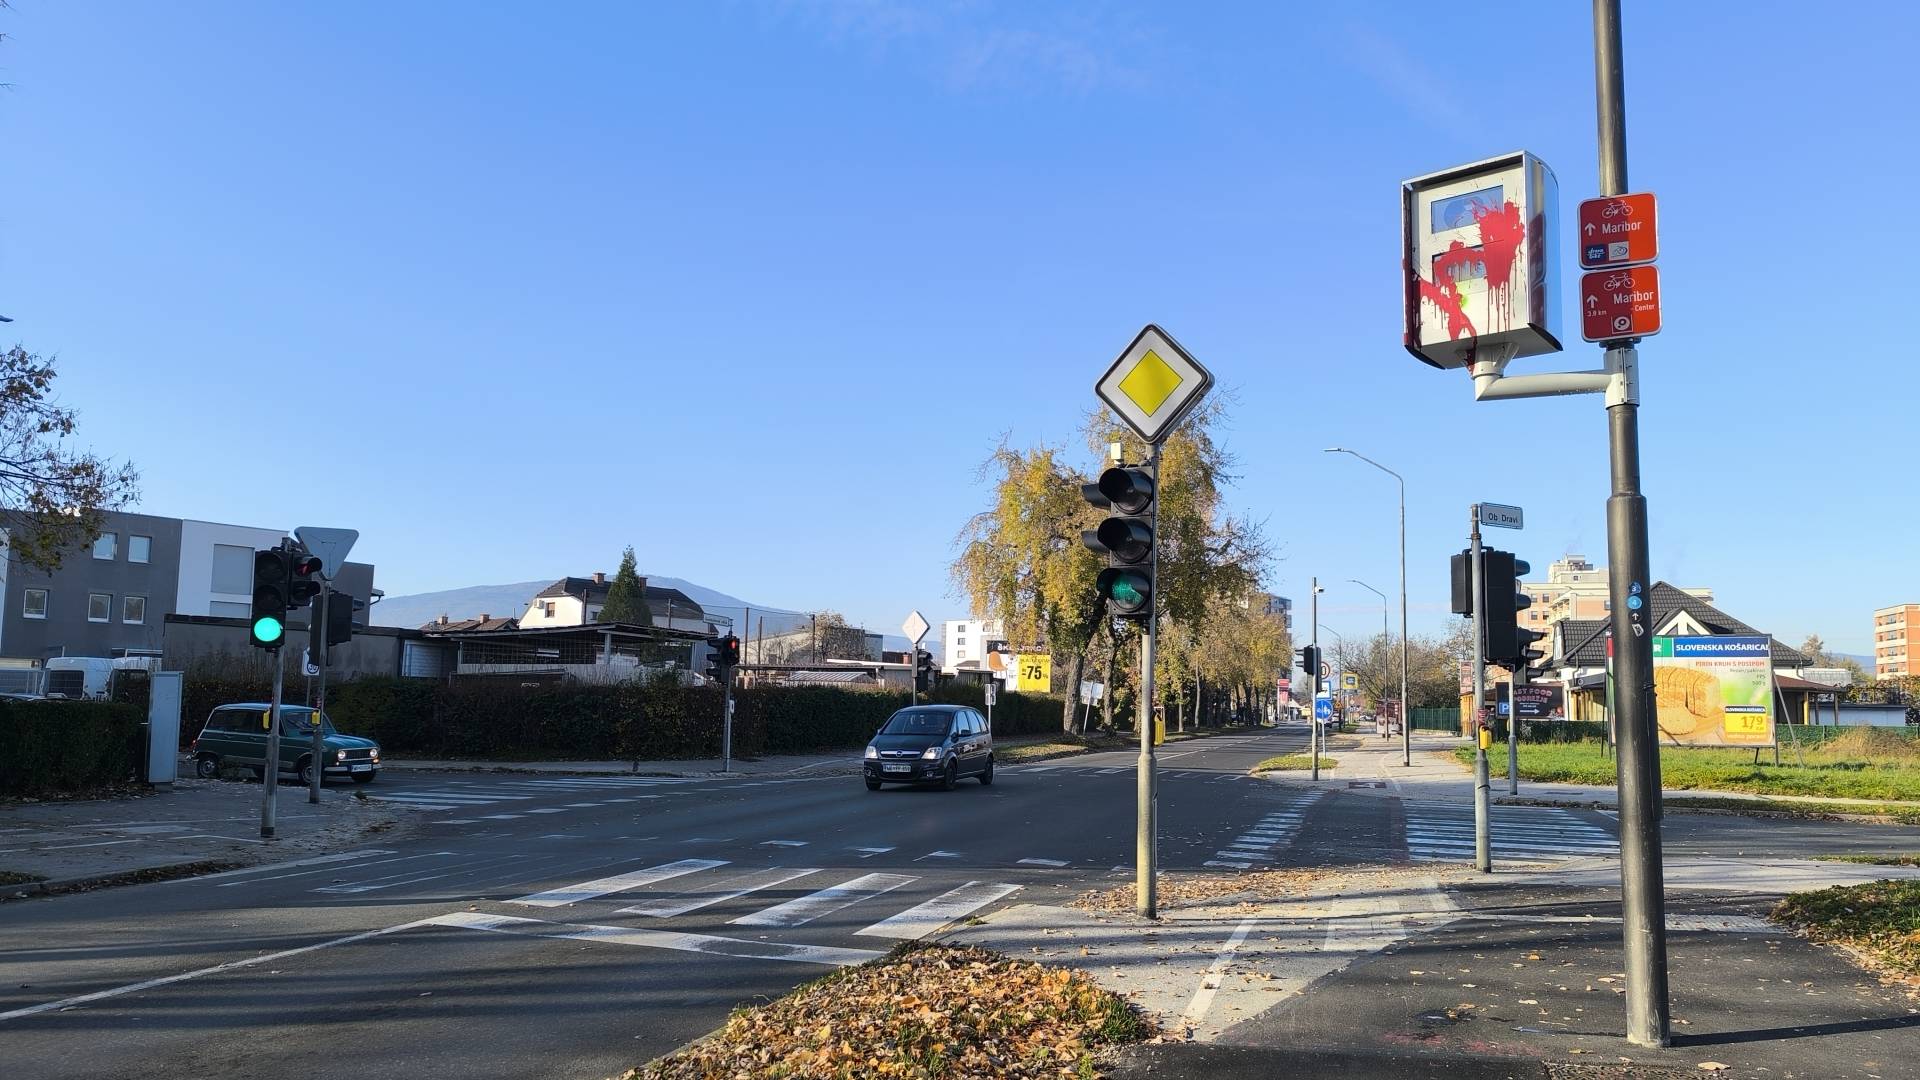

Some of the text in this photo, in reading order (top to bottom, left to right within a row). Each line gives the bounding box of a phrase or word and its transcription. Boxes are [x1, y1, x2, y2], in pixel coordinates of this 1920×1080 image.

[1602, 221, 1642, 234] Maribor
[1613, 290, 1654, 304] Maribor
[1488, 512, 1518, 524] Ob Dravi
[1676, 643, 1723, 651] SLOVENSKA
[1529, 688, 1553, 697] FOOD
